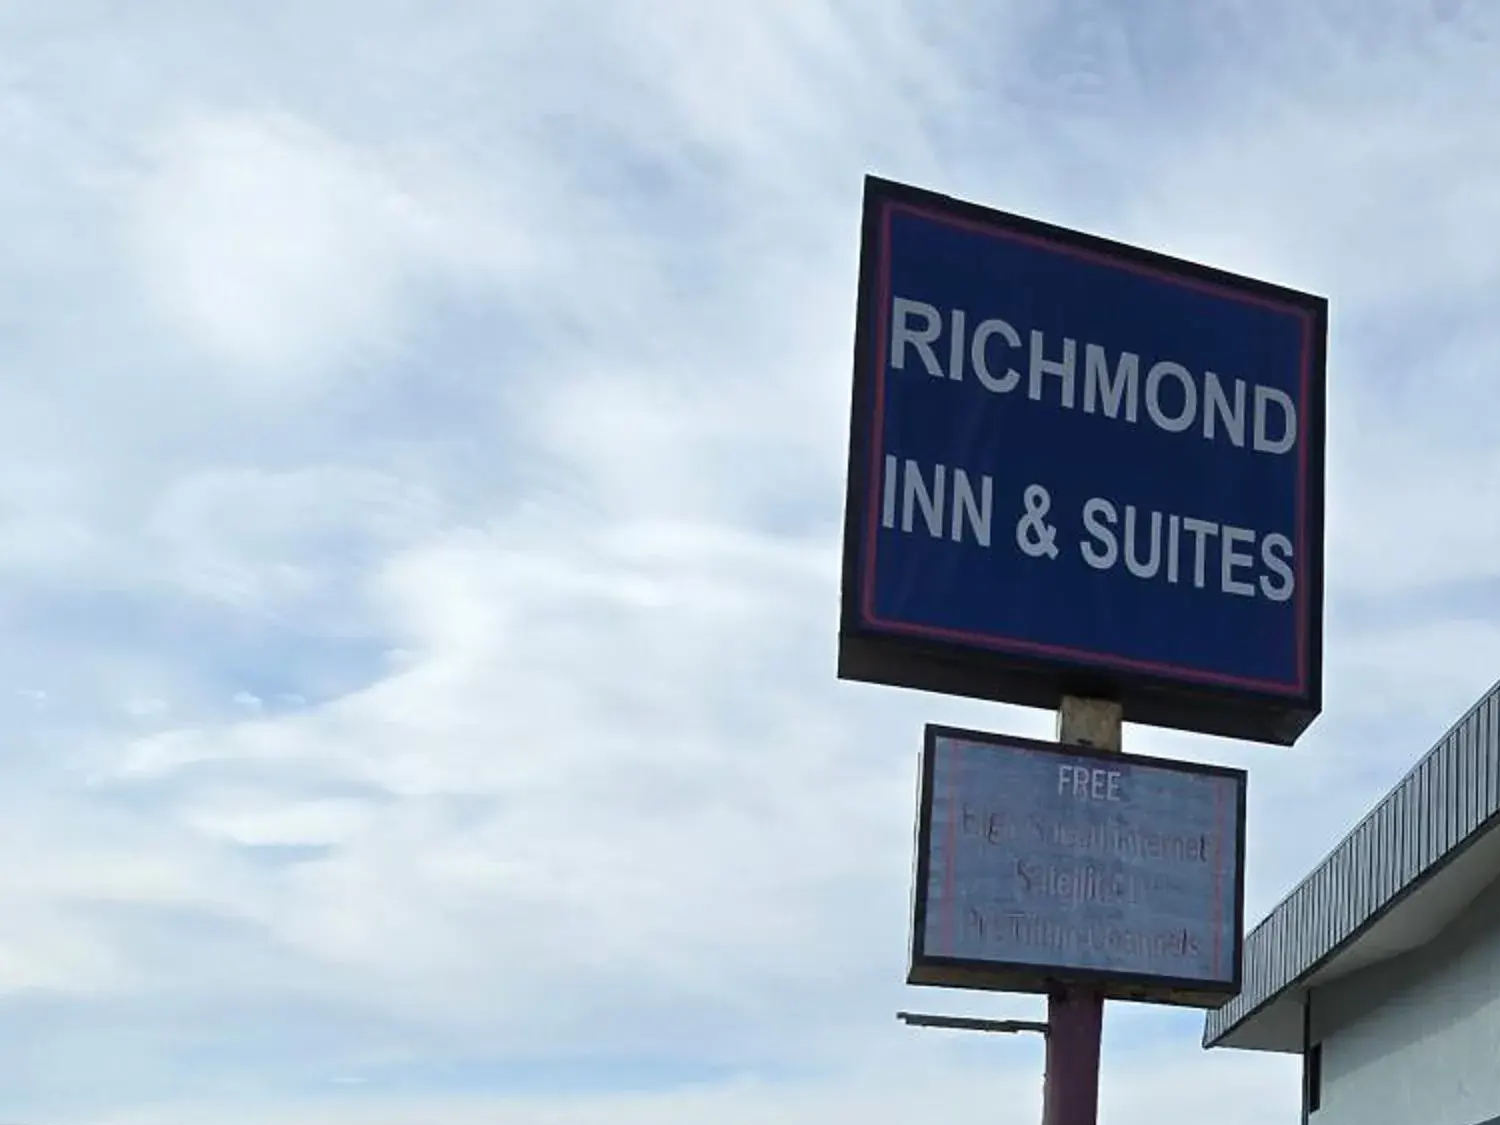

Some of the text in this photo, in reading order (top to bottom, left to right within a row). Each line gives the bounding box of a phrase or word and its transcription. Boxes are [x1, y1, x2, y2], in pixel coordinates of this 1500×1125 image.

[890, 296, 1297, 455] RICHMOND
[882, 454, 1295, 602] INN & SUITES
[1058, 765, 1122, 802] FREE
